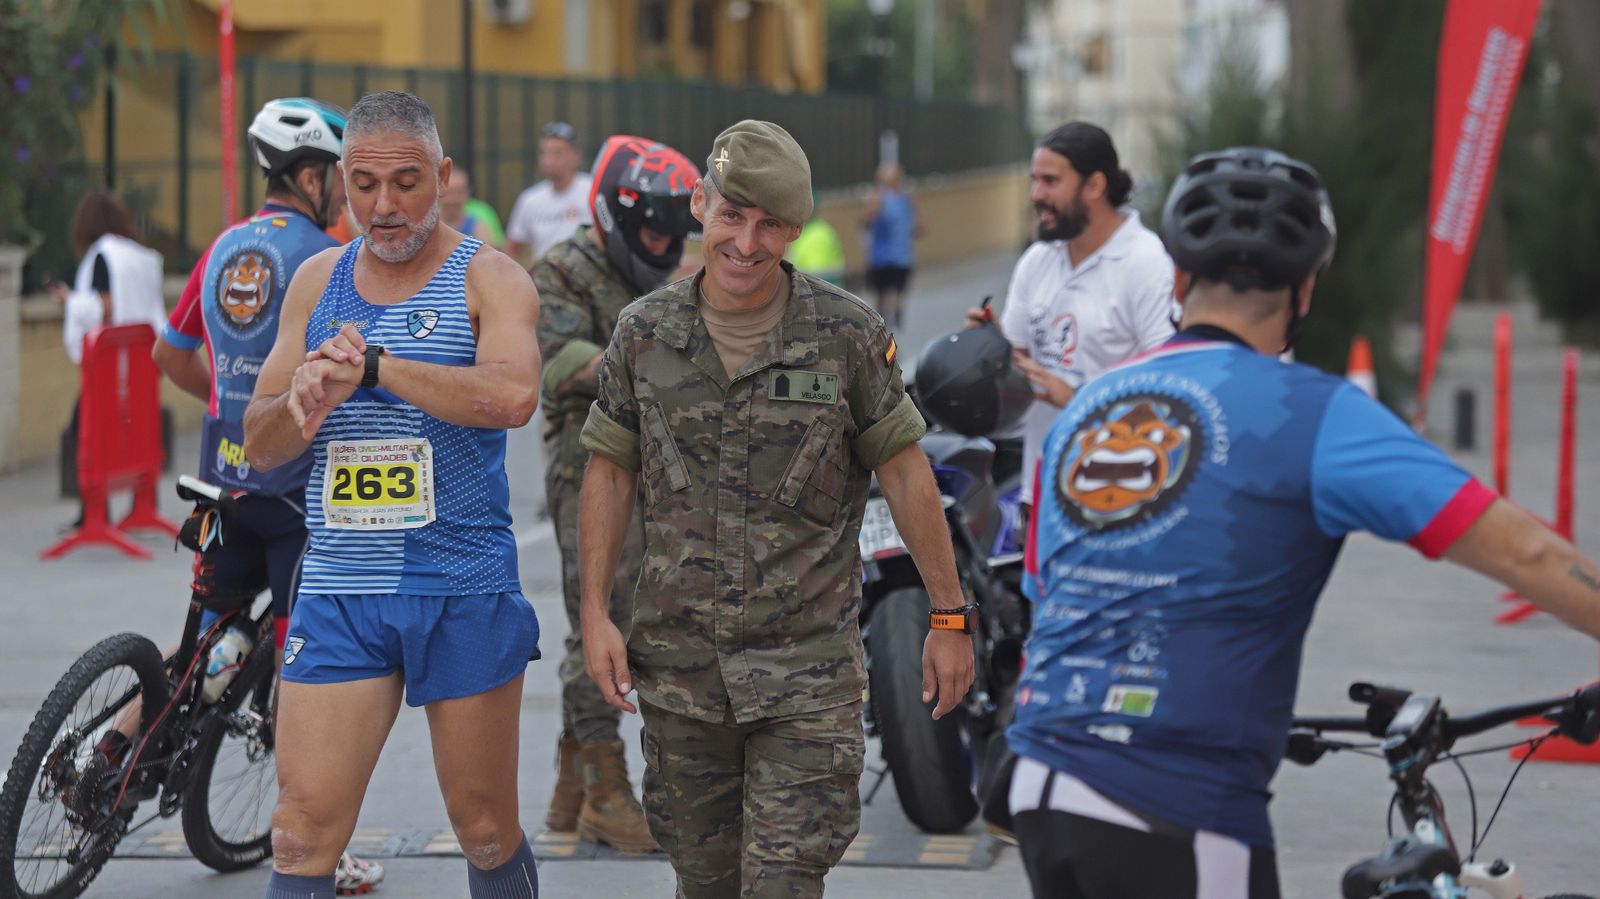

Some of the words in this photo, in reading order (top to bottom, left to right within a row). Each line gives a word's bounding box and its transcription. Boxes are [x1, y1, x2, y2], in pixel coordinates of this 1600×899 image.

[294, 128, 322, 144] KIKO
[801, 391, 832, 401] VELASCO
[351, 453, 359, 463] 2
[361, 453, 408, 462] CIUDADES
[332, 466, 416, 501] 263
